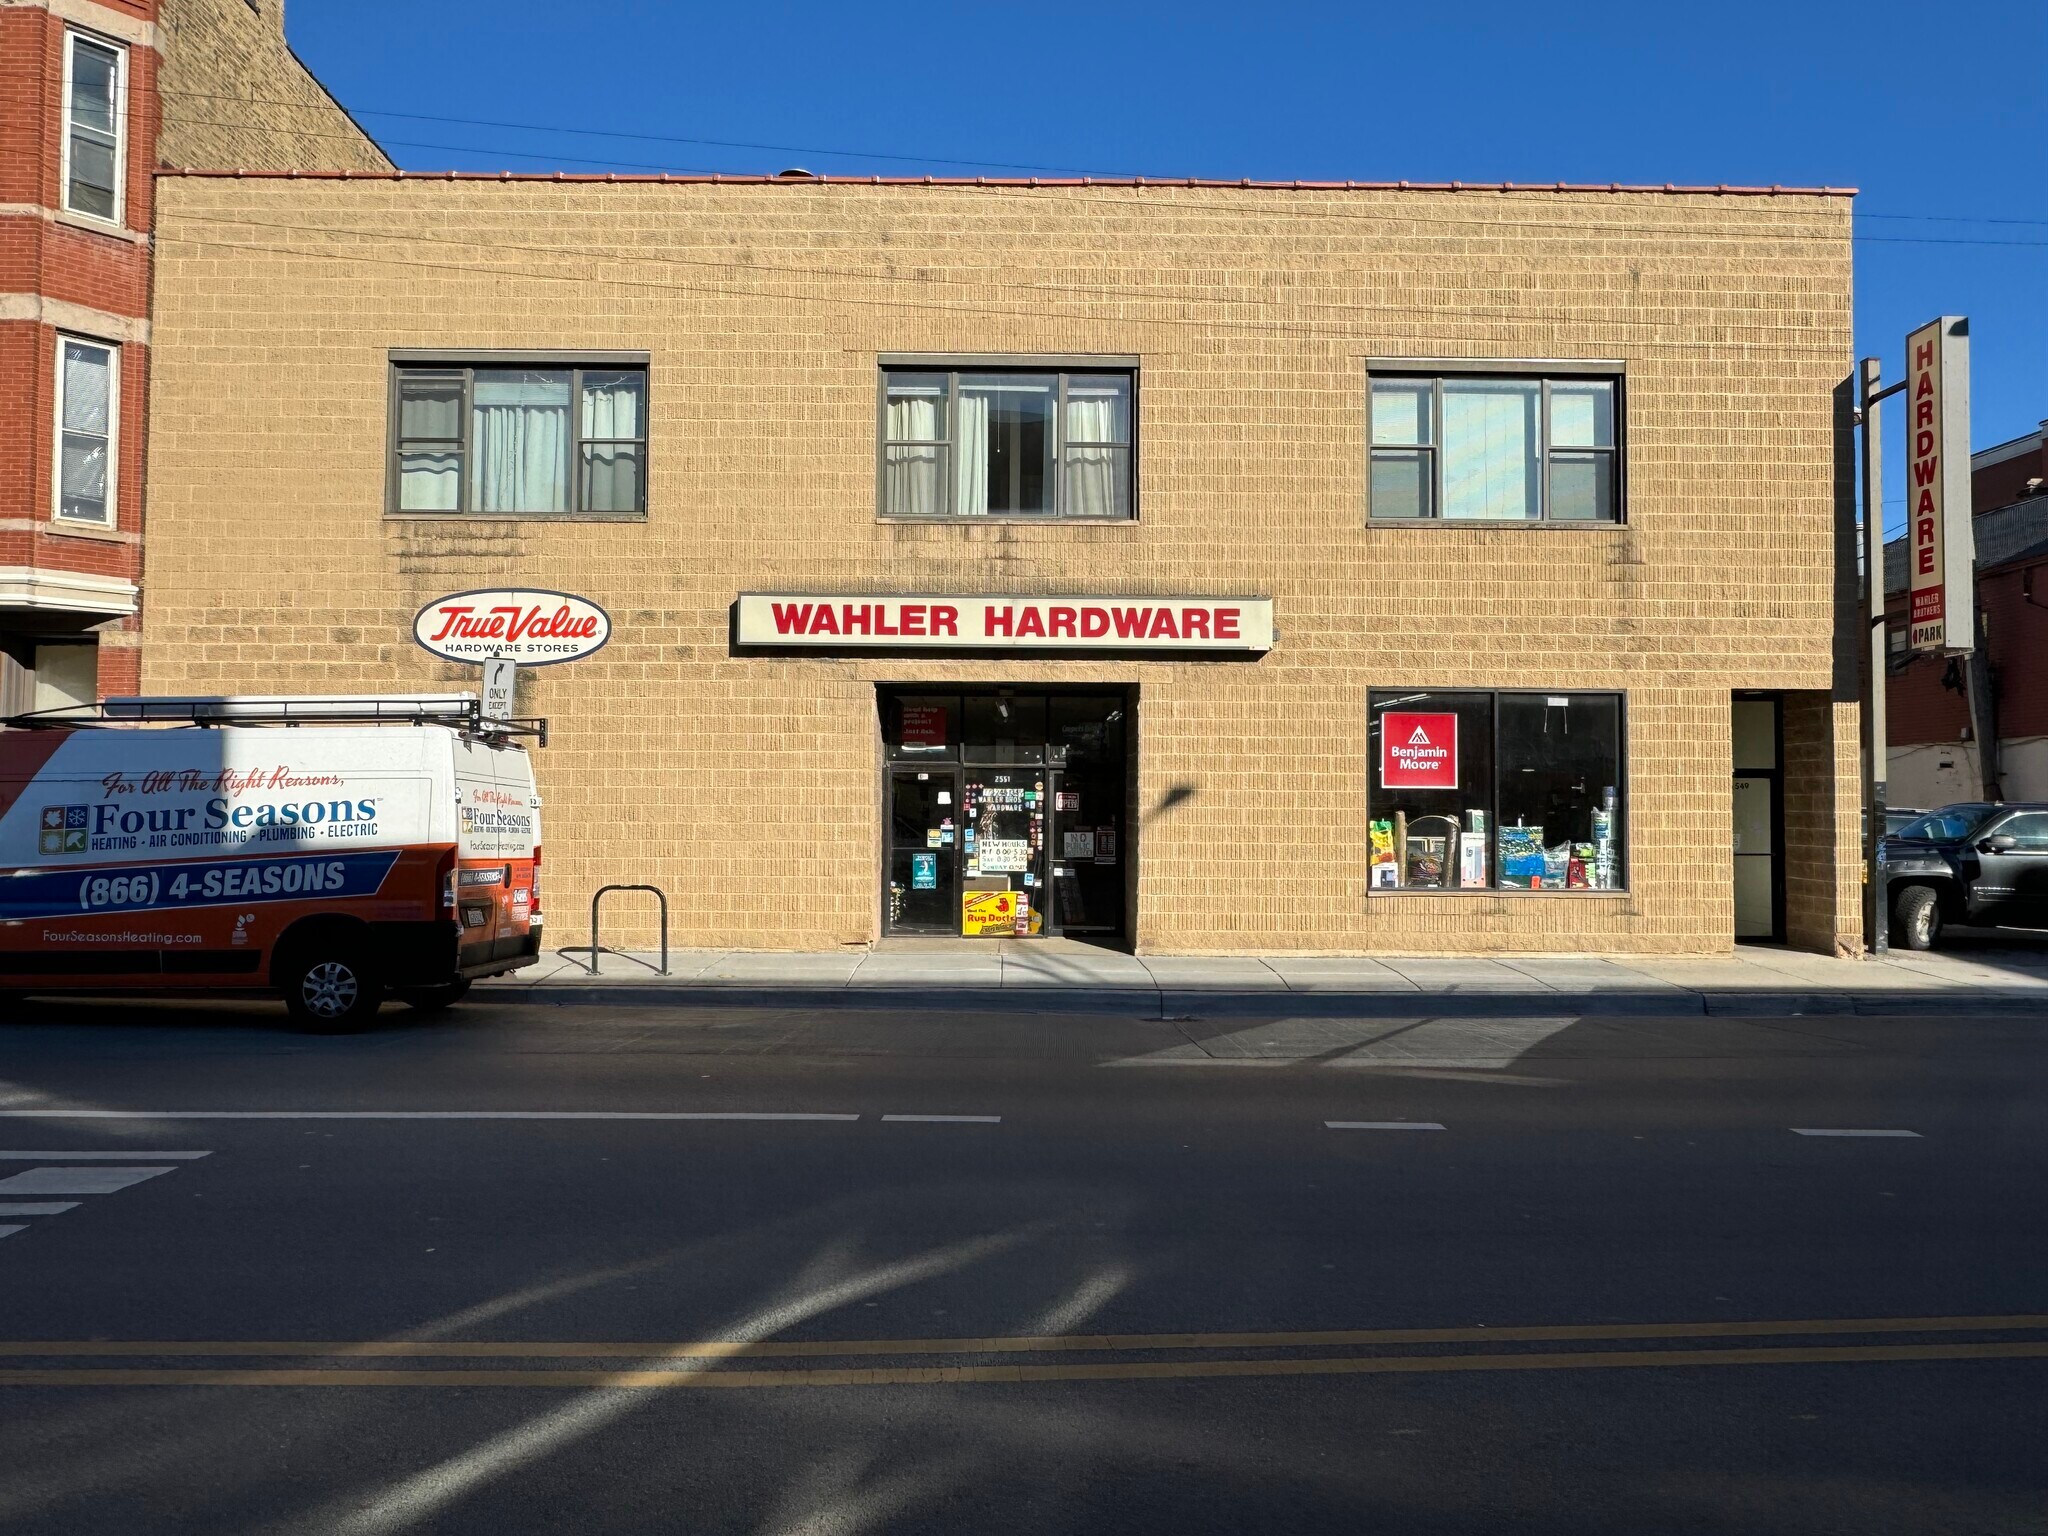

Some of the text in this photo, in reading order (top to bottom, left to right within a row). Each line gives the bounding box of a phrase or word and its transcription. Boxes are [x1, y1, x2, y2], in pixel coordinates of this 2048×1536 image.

[1914, 340, 1937, 575] HARDWARE
[430, 605, 597, 642] True Value
[771, 603, 1241, 639] WAHLER HARDWARE
[1919, 625, 1942, 643] PARK
[445, 644, 579, 652] HARDWARE STORES
[489, 687, 507, 699] ONLY
[489, 701, 507, 710] EXCEPT
[1391, 746, 1447, 760] Benjamin
[1400, 759, 1440, 769] Moore
[102, 771, 136, 798] For
[141, 771, 176, 795] All
[178, 769, 209, 793] The
[212, 767, 265, 798] Right
[1734, 782, 1749, 790] 549
[92, 797, 377, 835] Four Seasons
[473, 807, 531, 827] Four Seasons
[91, 823, 378, 851] HEATING AIR CONDITIONING PLUMBING ELECTRIC
[79, 861, 345, 909] (866) 4-SEASONS
[967, 914, 986, 923] Rug
[43, 930, 202, 944] FourSeasonsHeating.com
